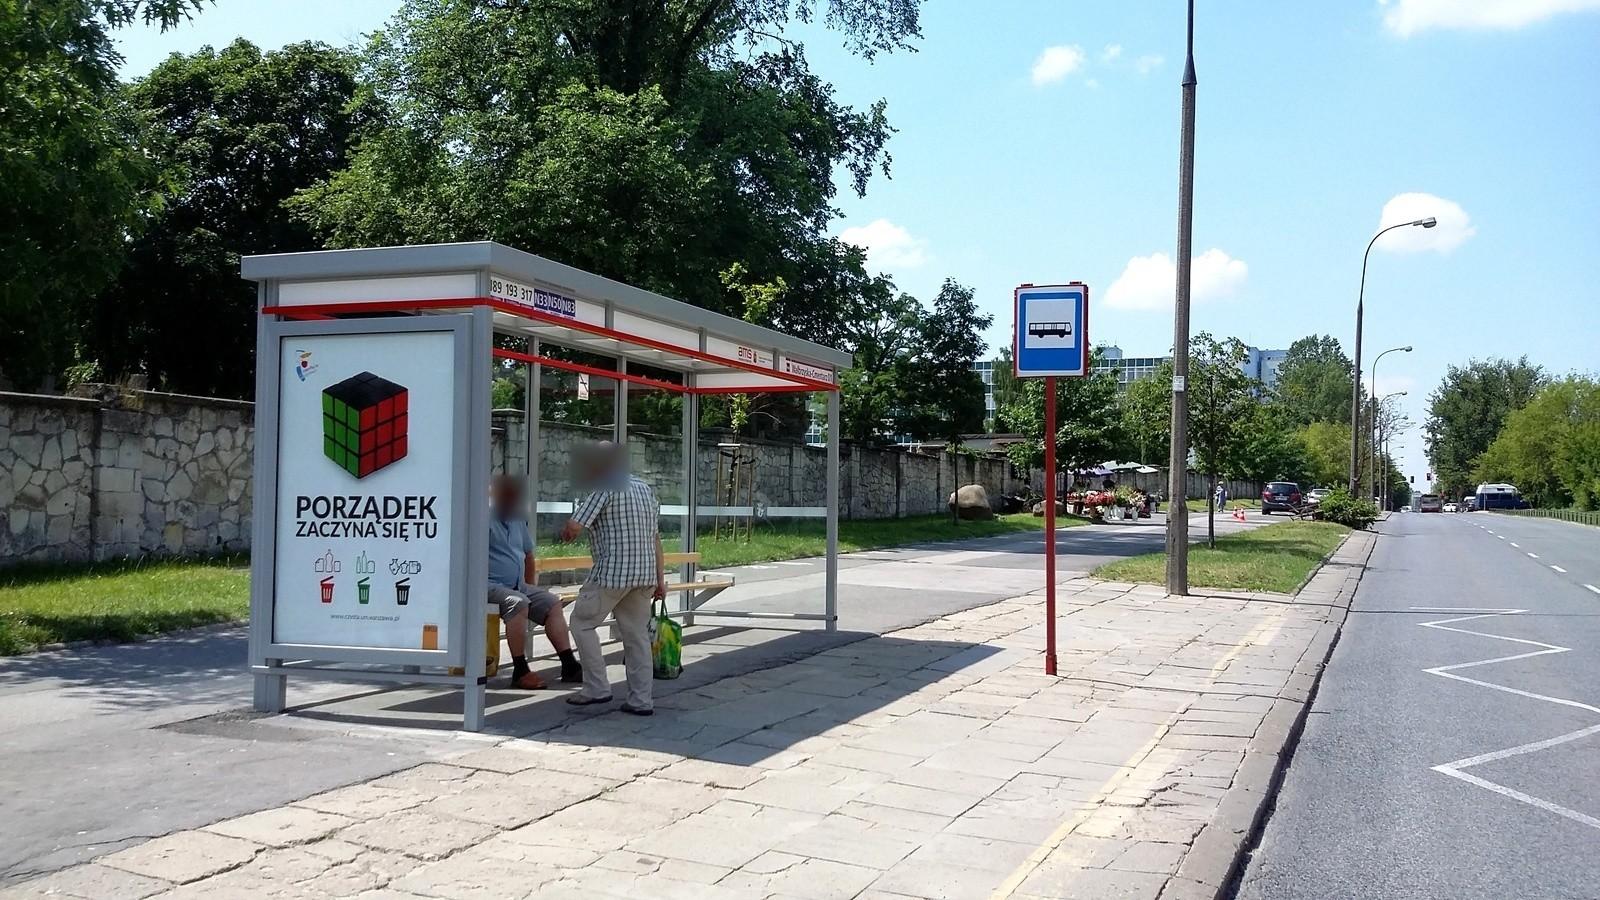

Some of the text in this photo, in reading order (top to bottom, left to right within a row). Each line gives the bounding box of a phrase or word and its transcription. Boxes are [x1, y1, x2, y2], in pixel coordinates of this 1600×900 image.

[506, 284, 518, 297] 193
[521, 288, 533, 302] 317
[534, 292, 548, 307] N33
[548, 296, 562, 310] N50
[563, 300, 575, 313] N83
[296, 496, 437, 524] PORZĄDEK
[296, 521, 437, 542] ZACZYNA SIĘ TU
